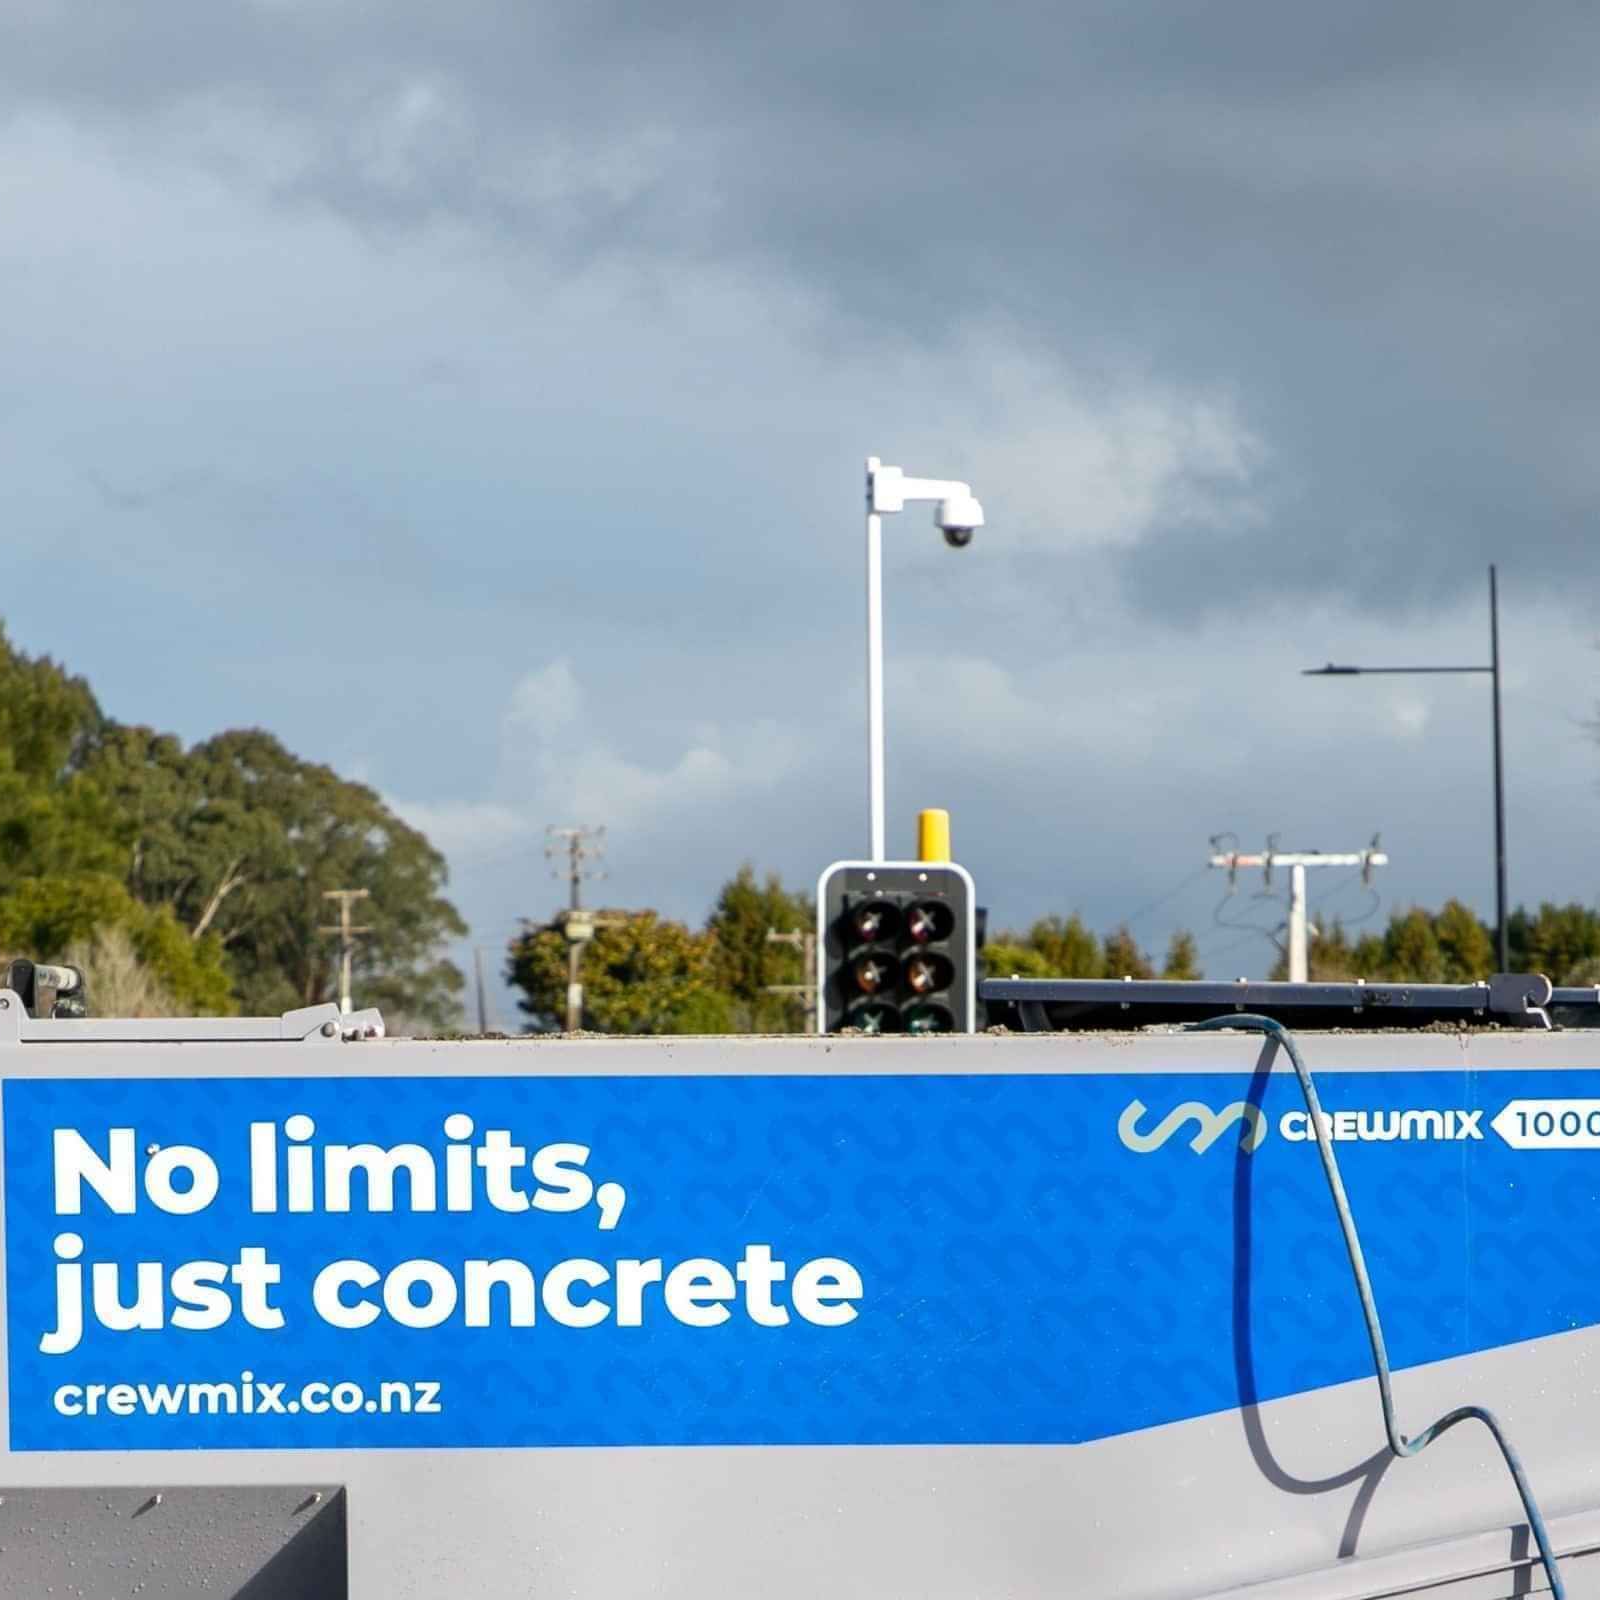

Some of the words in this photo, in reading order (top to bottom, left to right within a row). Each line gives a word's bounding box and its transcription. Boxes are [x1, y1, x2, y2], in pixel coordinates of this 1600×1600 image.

[53, 1128, 219, 1215] No
[250, 1113, 626, 1230] limits,
[39, 1232, 285, 1354] just
[312, 1244, 863, 1331] concrete
[54, 1370, 442, 1416] crewmix.co.nz
